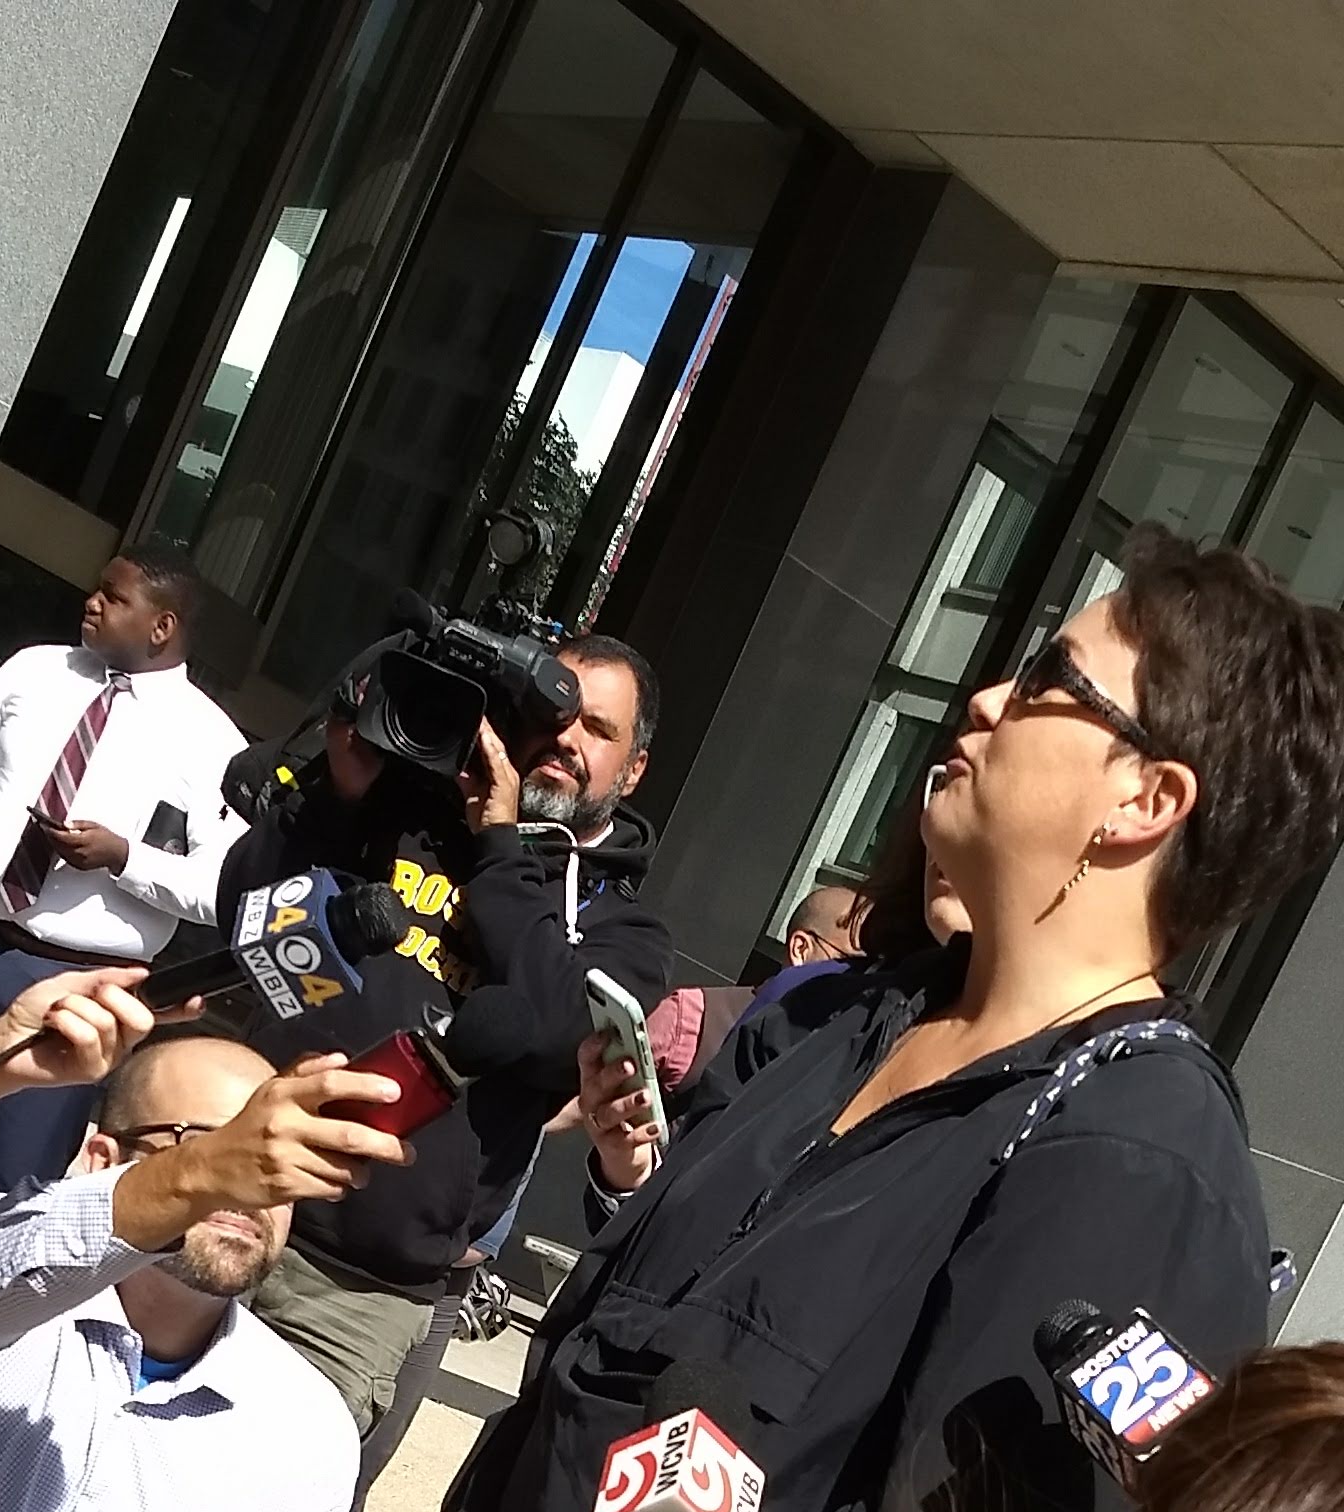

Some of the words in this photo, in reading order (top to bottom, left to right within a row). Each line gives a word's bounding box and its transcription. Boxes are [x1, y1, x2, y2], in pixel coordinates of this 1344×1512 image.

[267, 907, 308, 934] 4
[247, 948, 299, 1016] WBZ
[299, 974, 345, 1008] 4
[1070, 1320, 1149, 1388] BOSTON
[1091, 1331, 1188, 1436] 25
[1147, 1377, 1210, 1432] NEWS
[654, 1420, 690, 1497] WCVB
